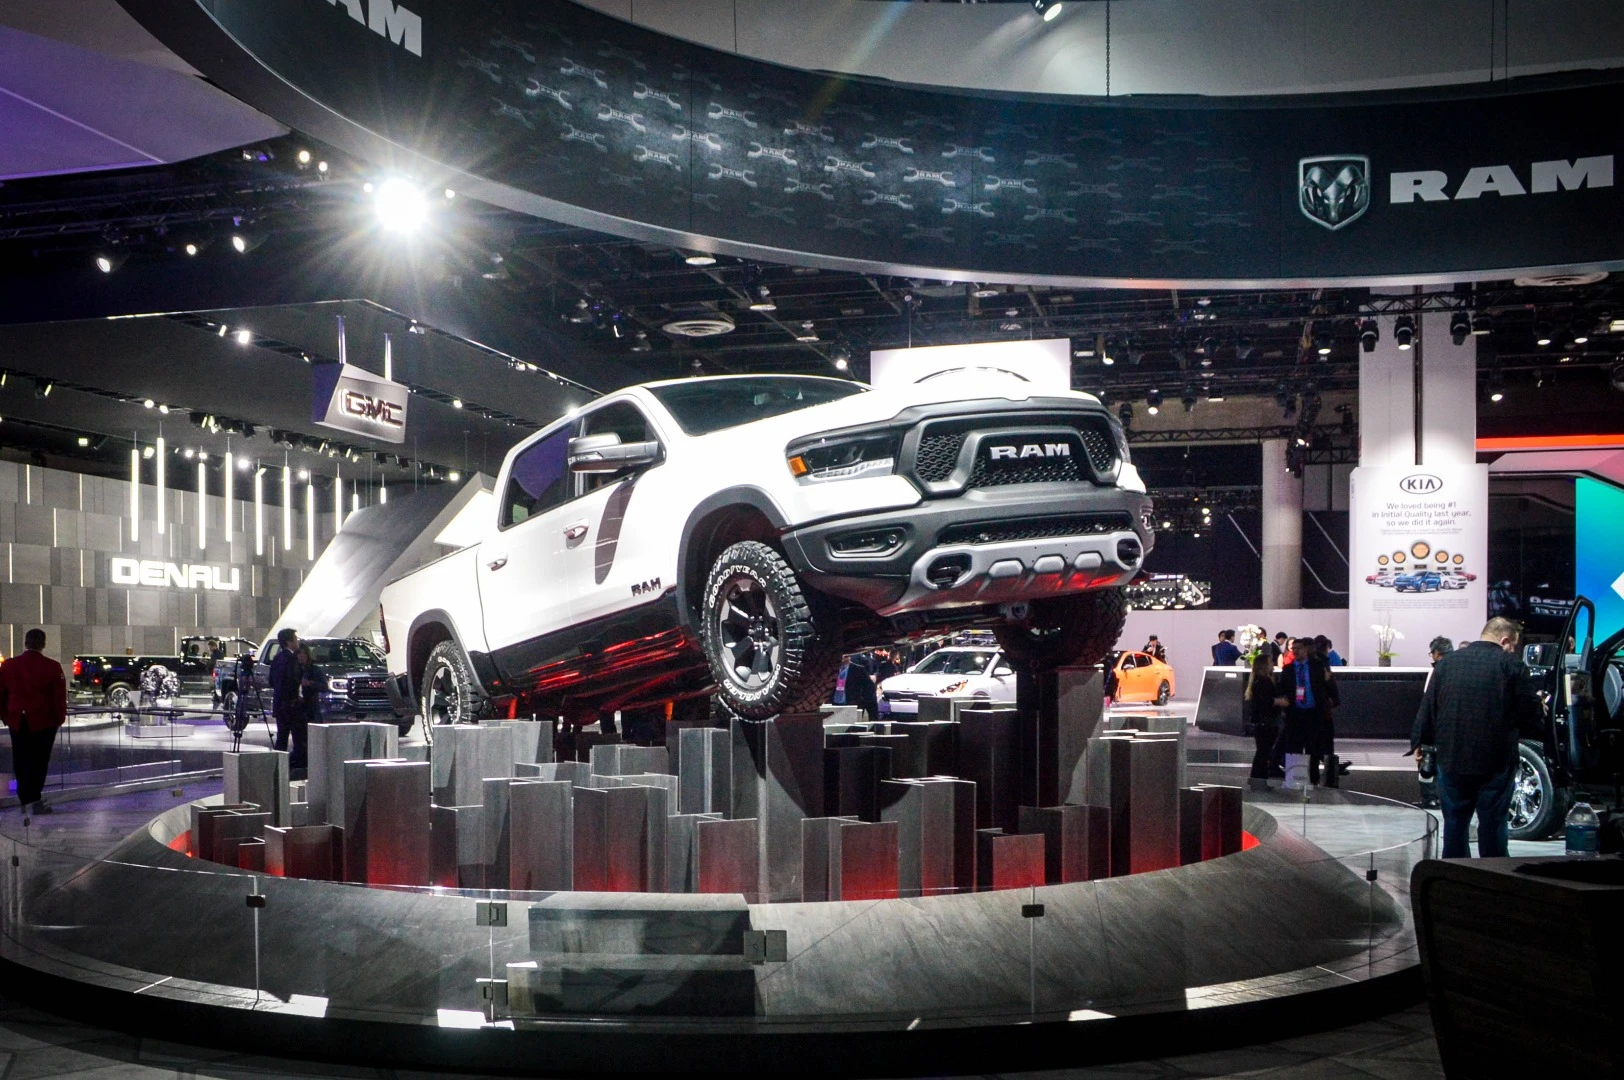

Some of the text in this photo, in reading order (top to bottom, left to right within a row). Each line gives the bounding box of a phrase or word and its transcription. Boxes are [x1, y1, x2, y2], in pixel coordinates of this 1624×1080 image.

[1390, 155, 1614, 204] RAM
[341, 389, 404, 428] GMC
[989, 443, 1071, 460] RAM
[1407, 479, 1436, 490] KIA
[1381, 511, 1403, 519] Initial
[1404, 511, 1433, 520] Quality
[1434, 510, 1450, 518] last
[1386, 501, 1457, 511] We loved being #1
[1411, 519, 1424, 527] did
[111, 557, 240, 591] DENALI
[631, 577, 661, 597] RAM
[708, 564, 767, 609] GOODYEAR
